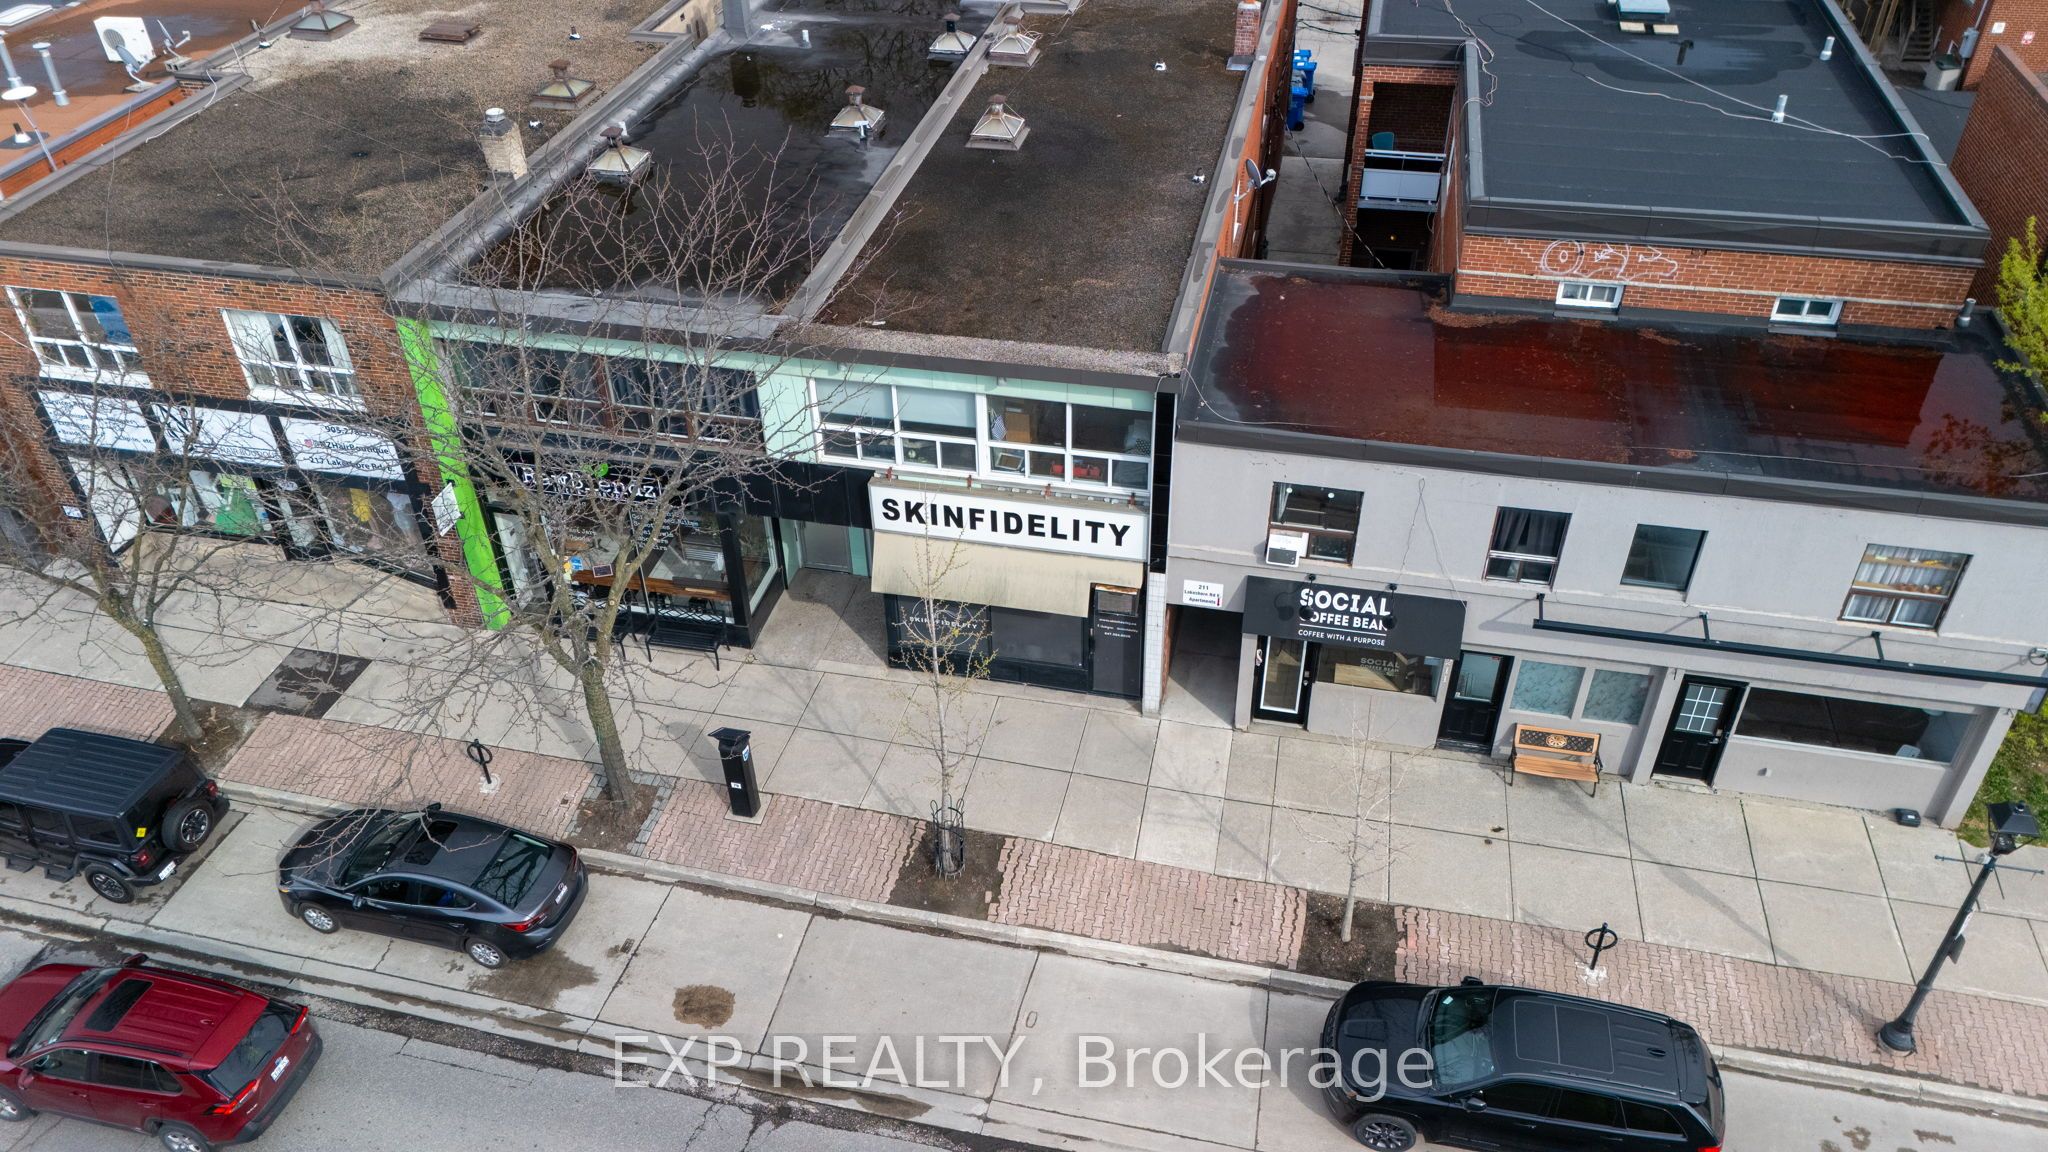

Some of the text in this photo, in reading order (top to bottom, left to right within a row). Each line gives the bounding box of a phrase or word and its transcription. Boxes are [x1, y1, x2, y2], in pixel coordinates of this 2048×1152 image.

[328, 458, 370, 470] Lakore
[881, 498, 1131, 547] SKINFIDELITY
[1189, 597, 1216, 605] Apartments
[1300, 588, 1391, 616] SOCIAL
[1300, 611, 1349, 627] OFFEE
[1298, 629, 1325, 639] COFFEE
[1326, 633, 1345, 641] WITH
[1353, 636, 1385, 647] PURPOSE
[1360, 657, 1400, 668] SOCIAL
